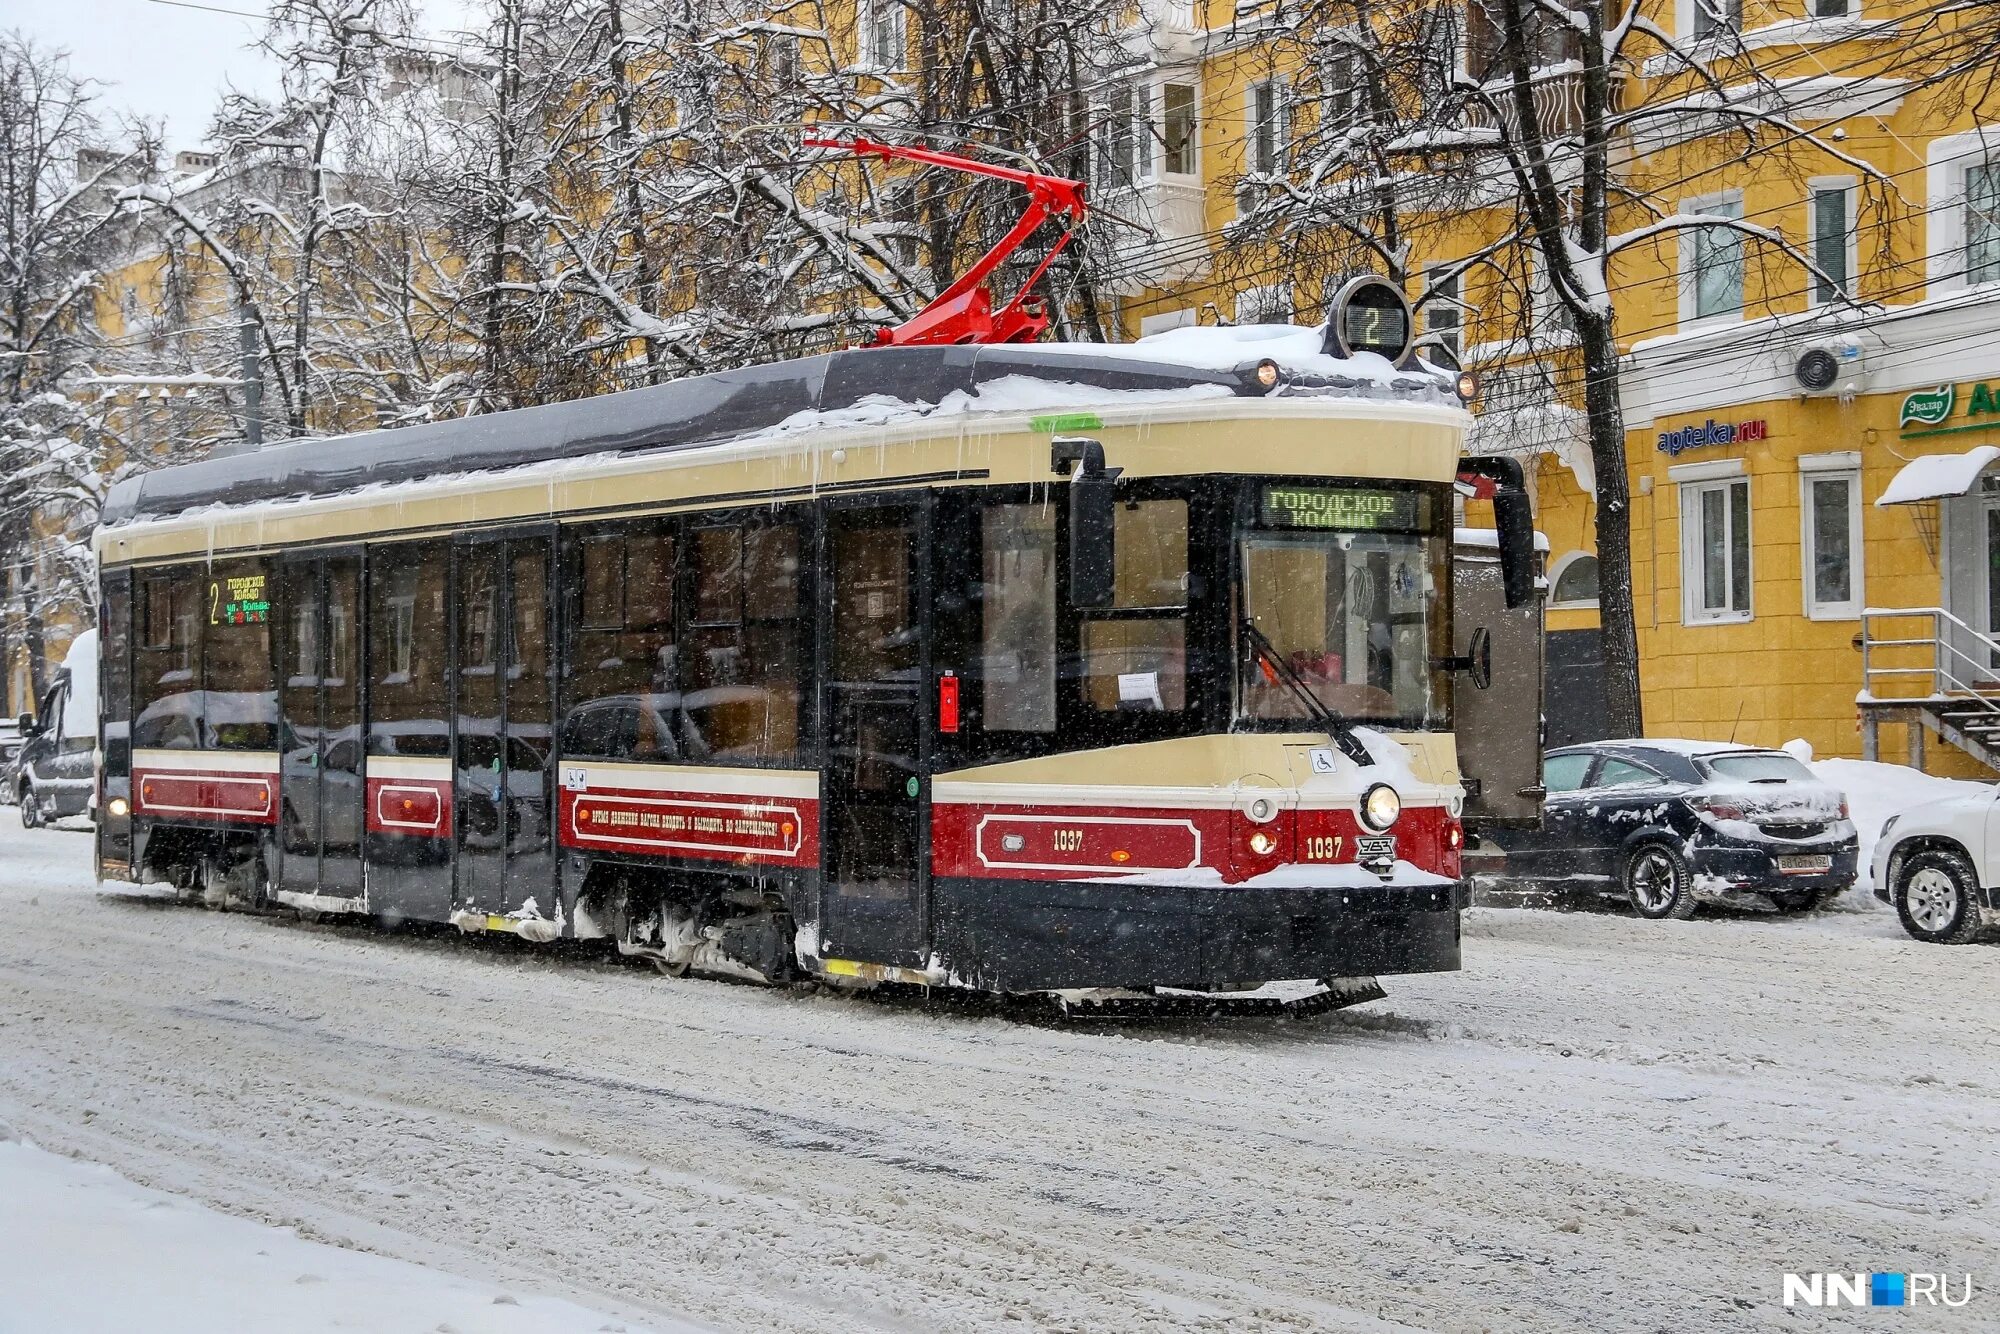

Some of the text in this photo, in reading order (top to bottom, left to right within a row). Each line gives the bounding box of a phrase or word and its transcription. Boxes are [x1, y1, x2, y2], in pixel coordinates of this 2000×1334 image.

[1365, 307, 1379, 344] 2
[1908, 401, 1943, 413] Эвалар
[1657, 419, 1766, 456] apteka.ru
[1270, 492, 1394, 513] ГОРОДСКОЕ
[227, 576, 265, 589] ГОРОДСКОЕ
[211, 583, 218, 624] 2
[1053, 829, 1083, 851] 1037
[1307, 836, 1342, 859] 1037
